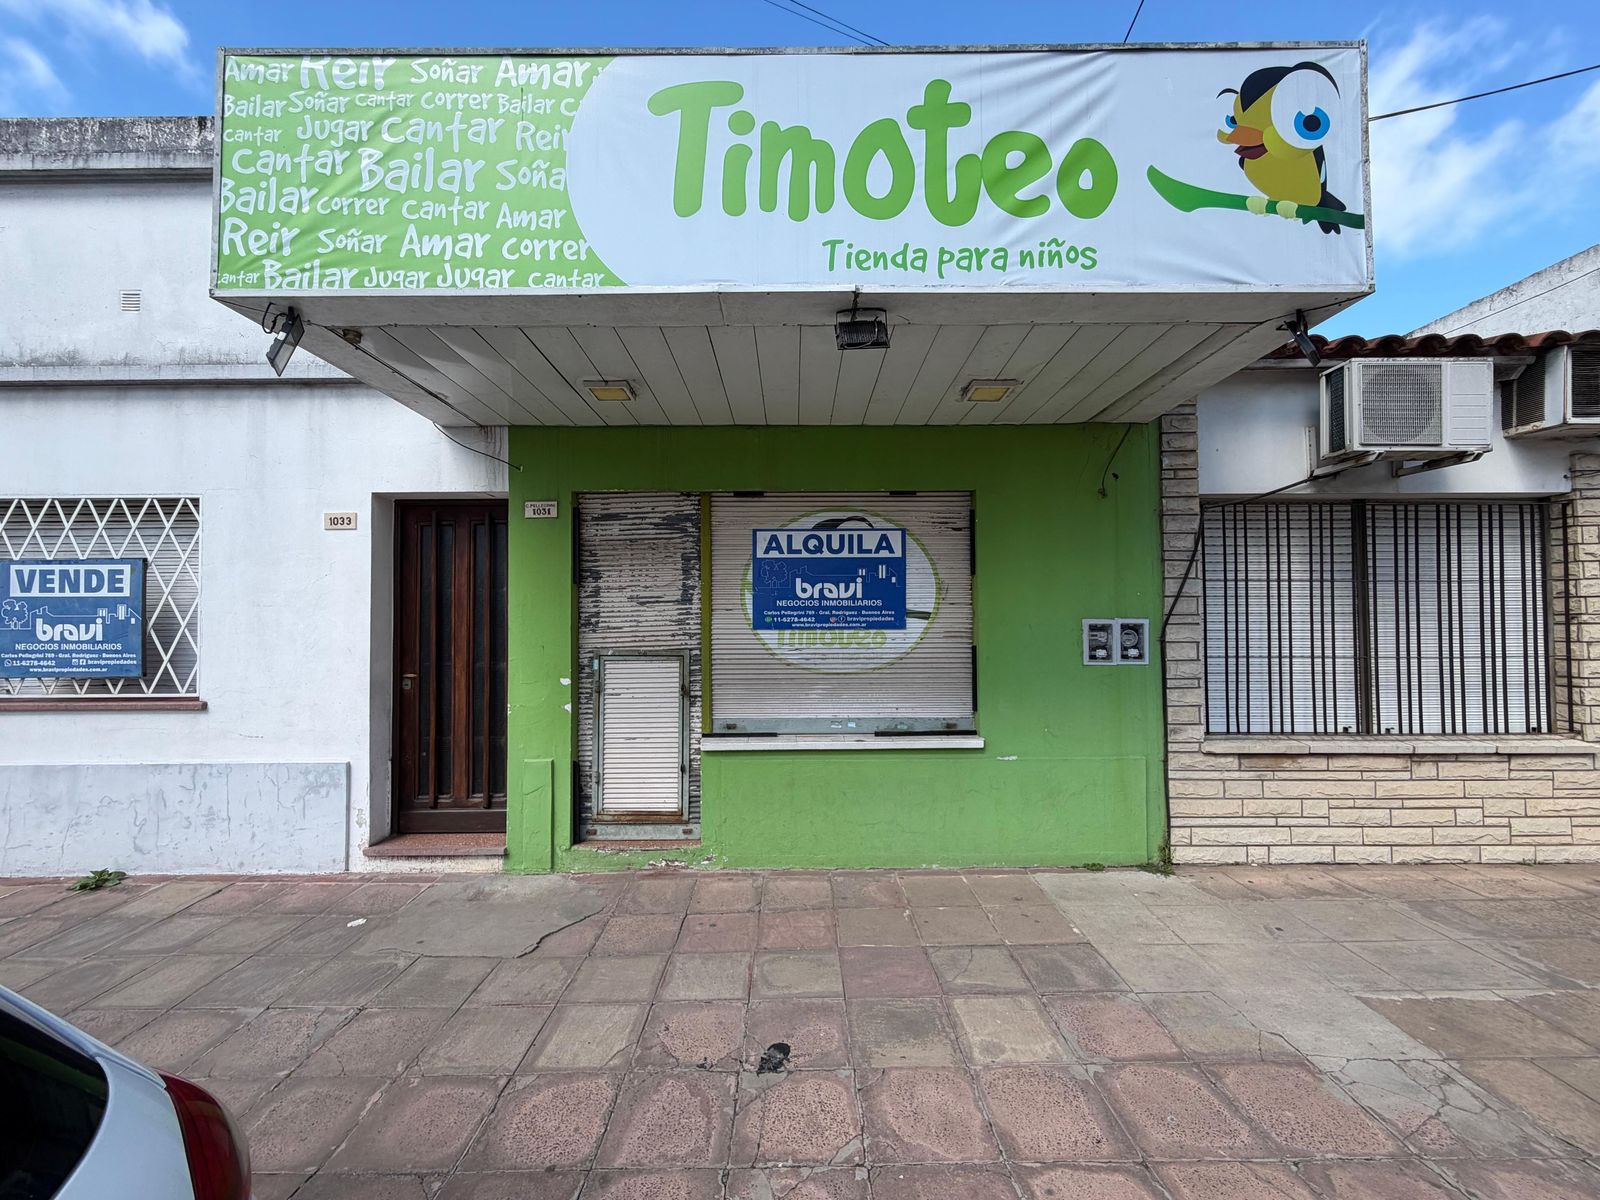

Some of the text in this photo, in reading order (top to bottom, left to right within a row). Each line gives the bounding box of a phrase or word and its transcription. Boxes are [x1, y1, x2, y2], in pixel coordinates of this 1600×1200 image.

[225, 56, 295, 84] Amar
[410, 58, 484, 84] Soñar
[495, 56, 591, 90] Amar
[223, 94, 287, 118] Bailar
[288, 91, 350, 114] Soñar
[497, 93, 555, 115] Bailar
[296, 114, 374, 147] Jugar
[647, 78, 1118, 227] Timoteo
[358, 147, 485, 193] Bailar
[221, 177, 319, 215] Bailar
[496, 202, 567, 231] Amar
[222, 217, 300, 257] Reir
[317, 228, 388, 254] Soñar
[400, 223, 491, 261] Amar
[262, 258, 359, 289] Bailar
[364, 266, 431, 289] Jugar
[436, 262, 515, 289] Jugar
[822, 237, 1098, 280] Tienda para niños
[329, 516, 352, 526] 1033
[763, 533, 895, 555] ALQUILA
[15, 568, 125, 594] VENDE
[795, 577, 863, 599] bravi
[35, 618, 103, 641] bravi
[15, 643, 122, 651] NEGOCIOS INMOBILIARIOS
